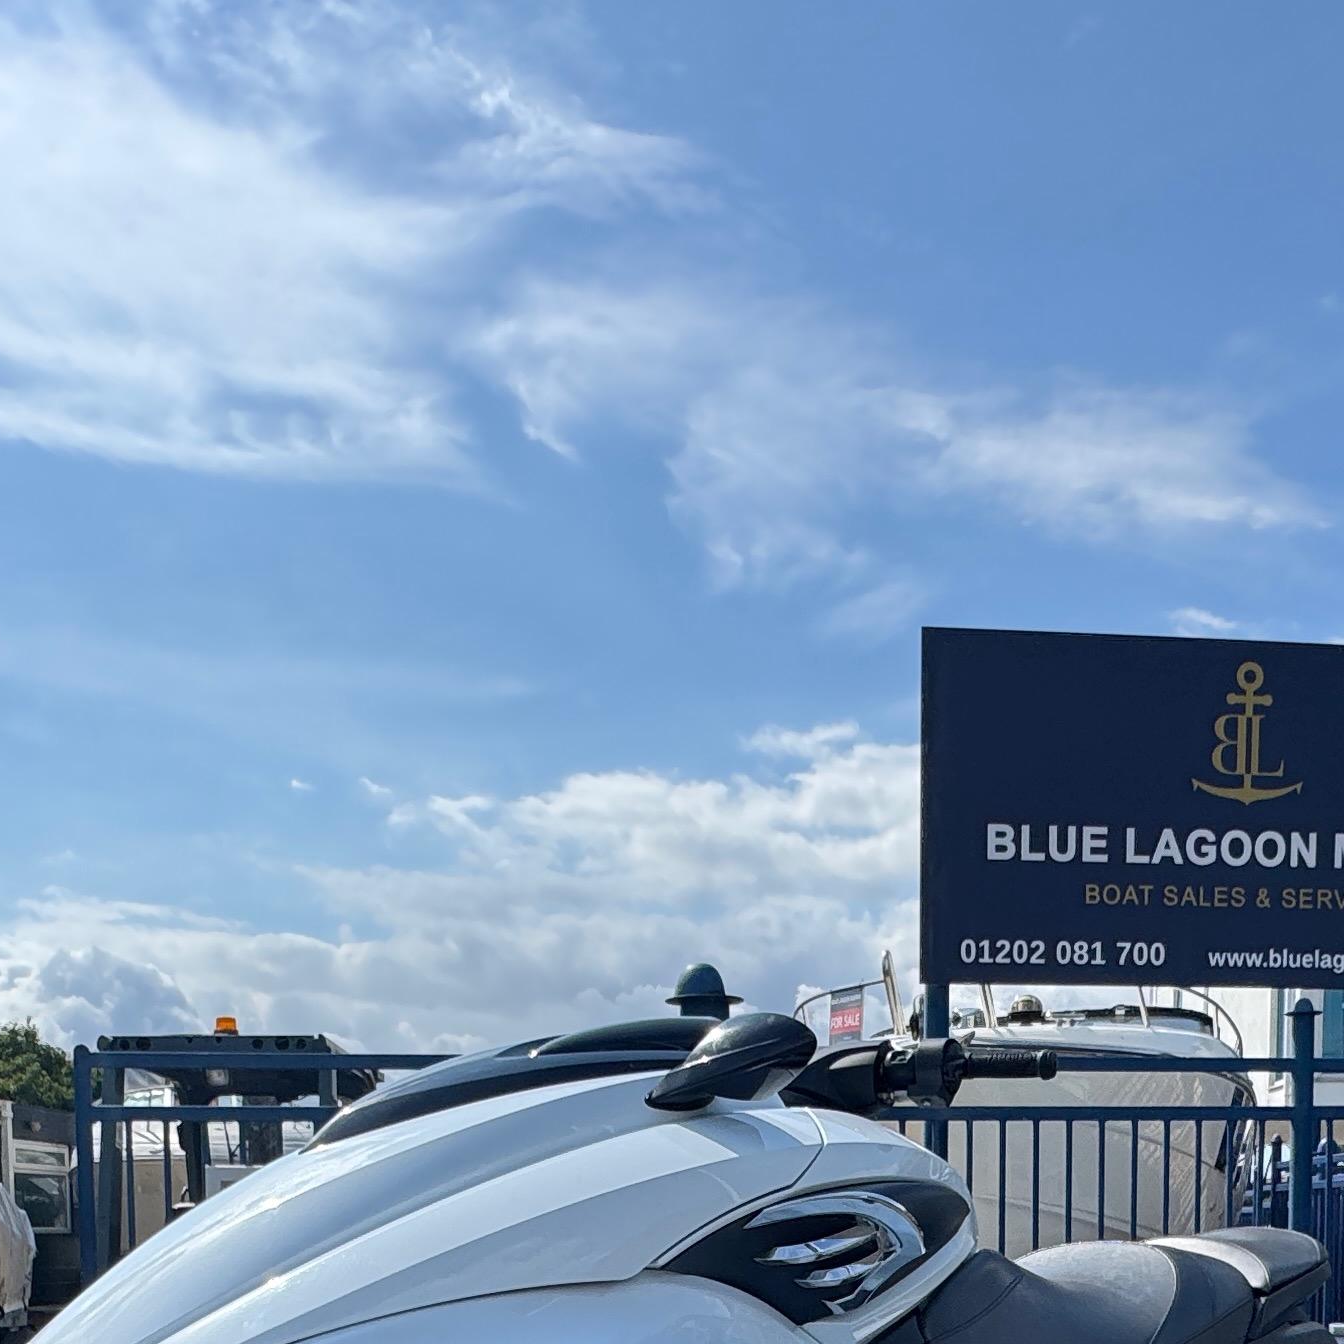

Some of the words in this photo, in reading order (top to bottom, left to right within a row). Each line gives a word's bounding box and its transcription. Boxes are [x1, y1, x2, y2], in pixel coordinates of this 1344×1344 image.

[987, 823, 1109, 863] BLUE
[1126, 827, 1318, 869] LAGOON
[1085, 884, 1154, 906] BOAT
[1163, 886, 1247, 908] SALES
[1256, 887, 1271, 909] &
[960, 938, 1046, 965] 01202
[1055, 940, 1107, 966] 081
[1115, 941, 1166, 967] 700
